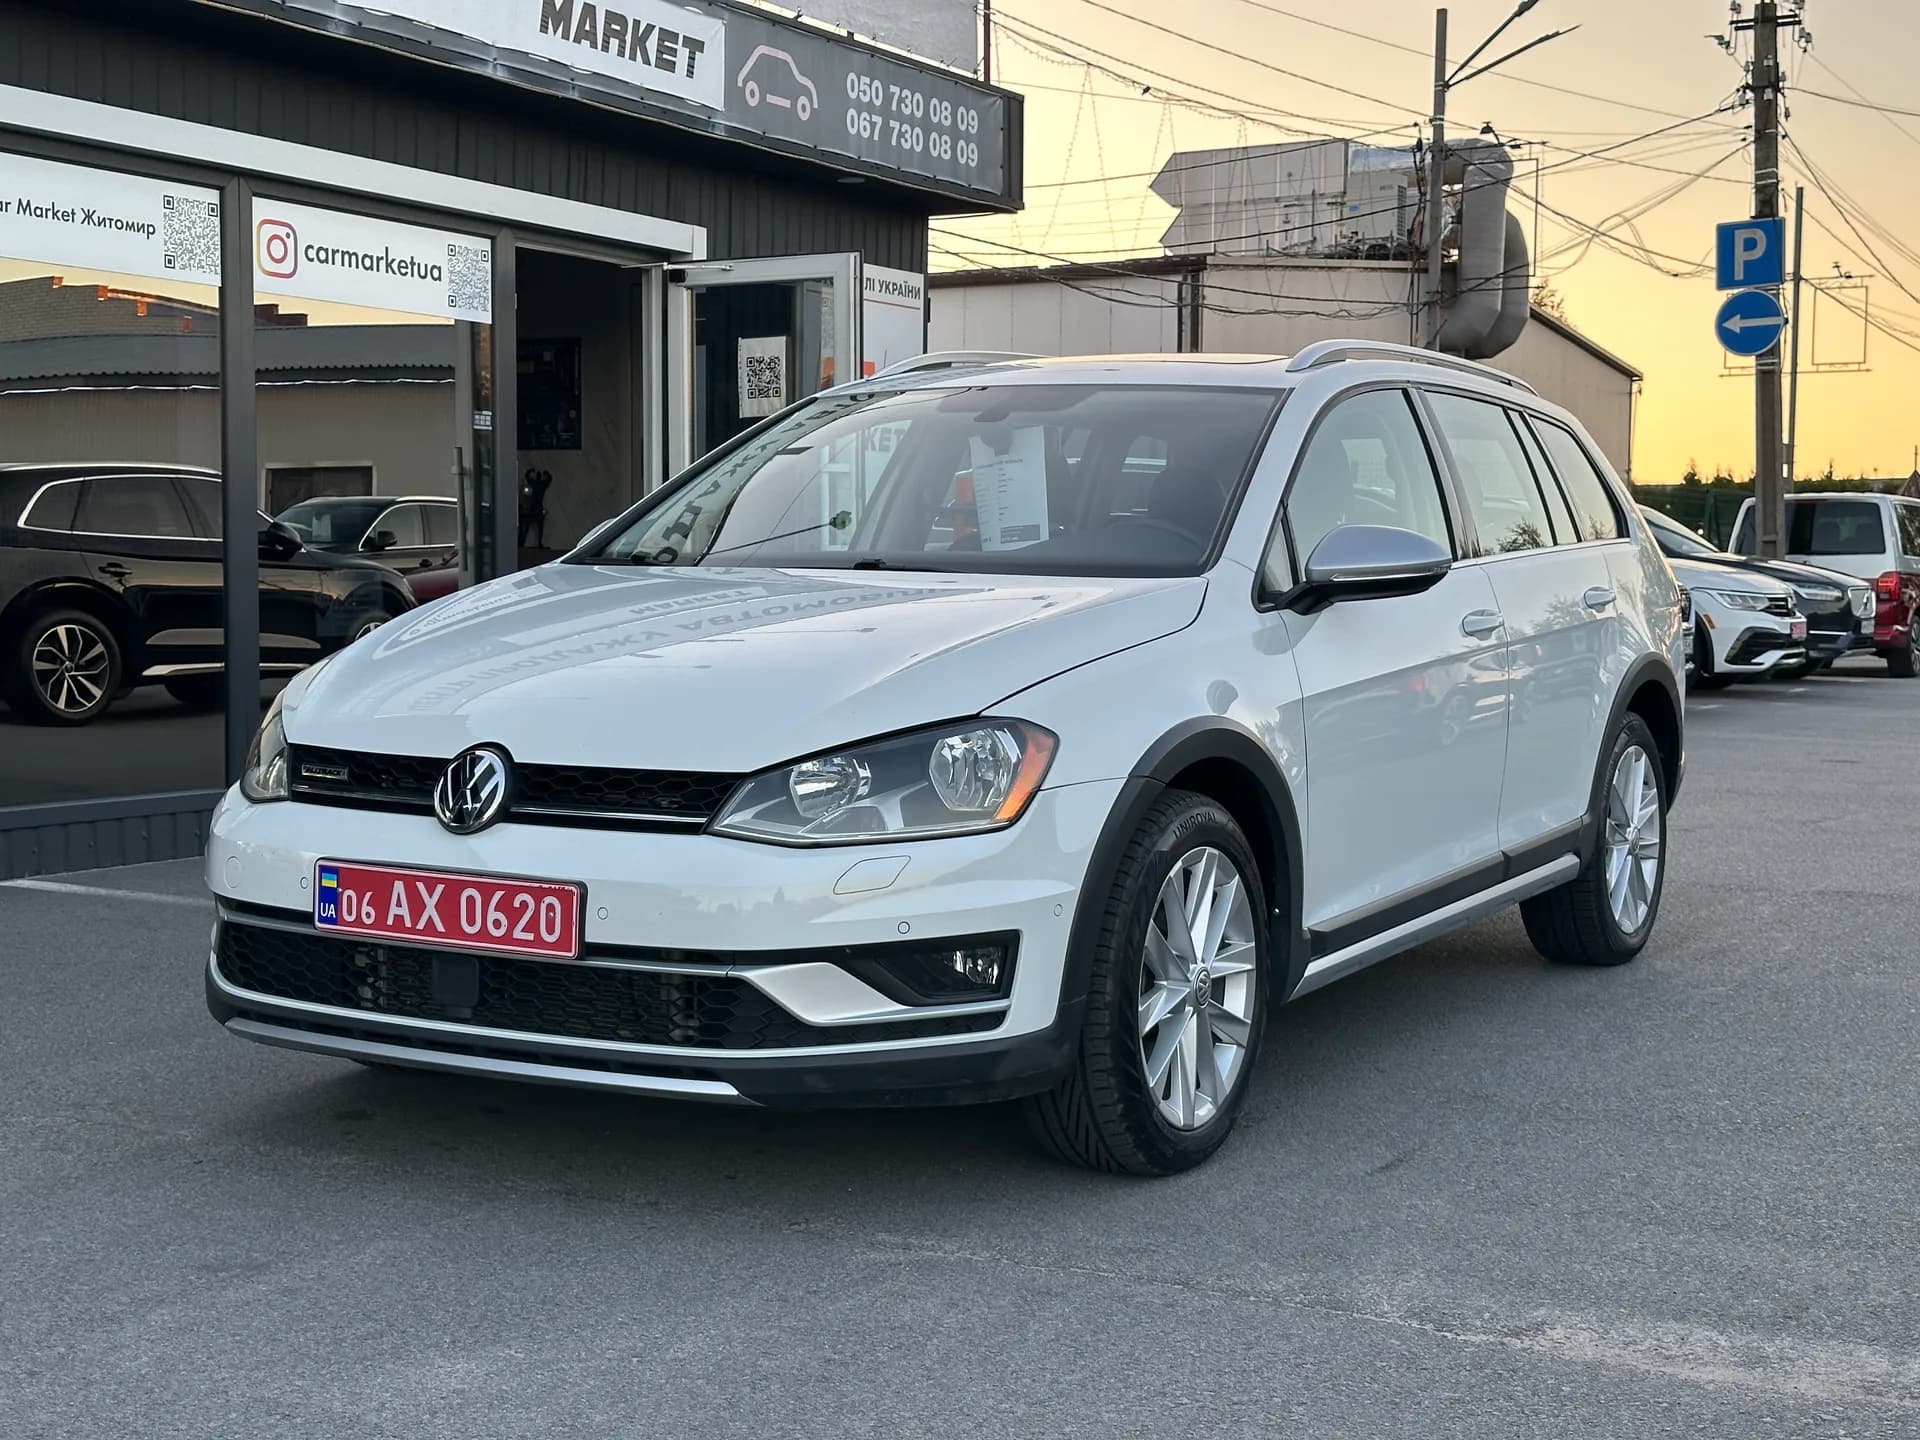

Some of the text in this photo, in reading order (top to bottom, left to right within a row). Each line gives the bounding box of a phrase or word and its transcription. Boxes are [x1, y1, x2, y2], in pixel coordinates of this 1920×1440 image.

[539, 0, 705, 79] MARKET
[846, 72, 979, 134] 050 730 08 09
[846, 108, 979, 168] 067 730 08 09
[16, 198, 76, 224] Market
[80, 207, 156, 240] Житомир
[303, 243, 442, 282] carmarketua
[1734, 228, 1767, 281] P
[878, 279, 921, 301] УКРАЇНИ
[1173, 811, 1219, 839] UNIROYAL
[320, 880, 561, 943] UA 06 AX 0620
